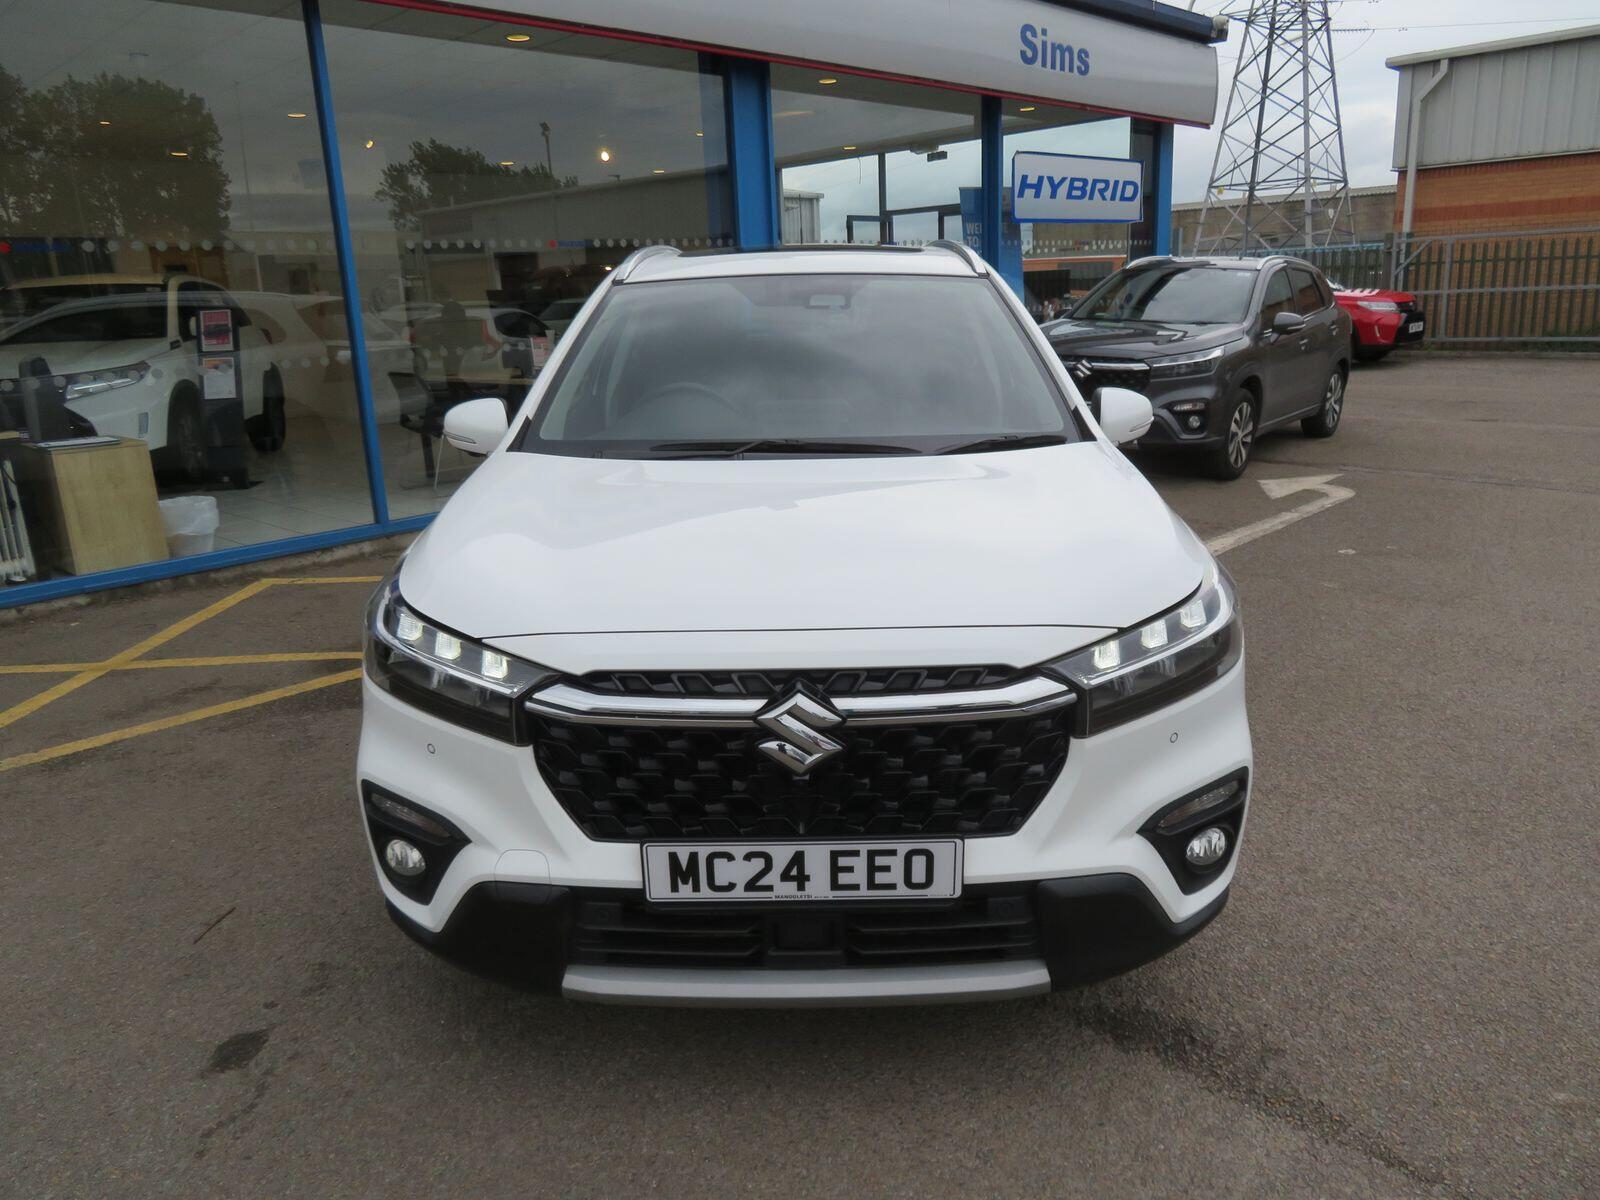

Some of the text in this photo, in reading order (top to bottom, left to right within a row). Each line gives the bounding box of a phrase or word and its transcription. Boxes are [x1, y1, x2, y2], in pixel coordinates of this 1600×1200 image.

[1020, 23, 1090, 76] Sims
[1017, 174, 1139, 202] HYBRID
[668, 848, 935, 893] MC24 EEO
